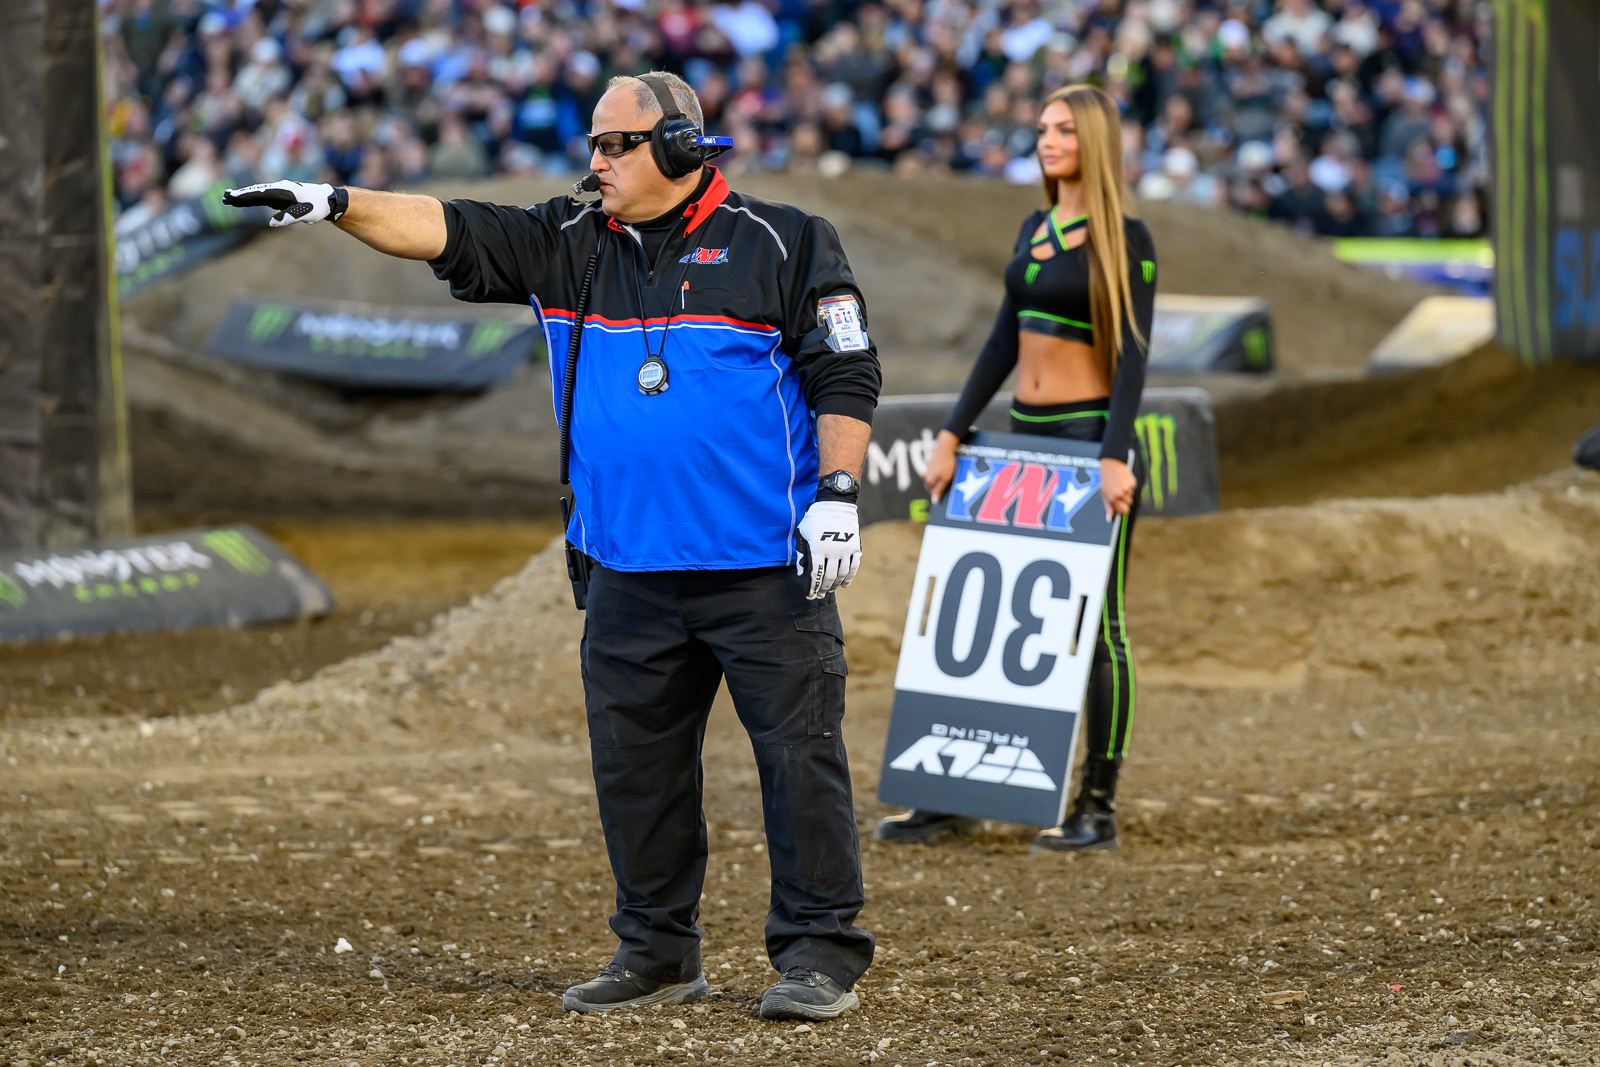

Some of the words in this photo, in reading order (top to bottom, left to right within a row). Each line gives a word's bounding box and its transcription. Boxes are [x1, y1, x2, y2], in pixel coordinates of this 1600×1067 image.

[679, 247, 729, 263] AMA
[946, 455, 1102, 533] AMA
[820, 531, 855, 543] FLY
[934, 551, 1072, 687] 30
[931, 723, 1030, 748] RACING
[889, 735, 1058, 792] FLY
